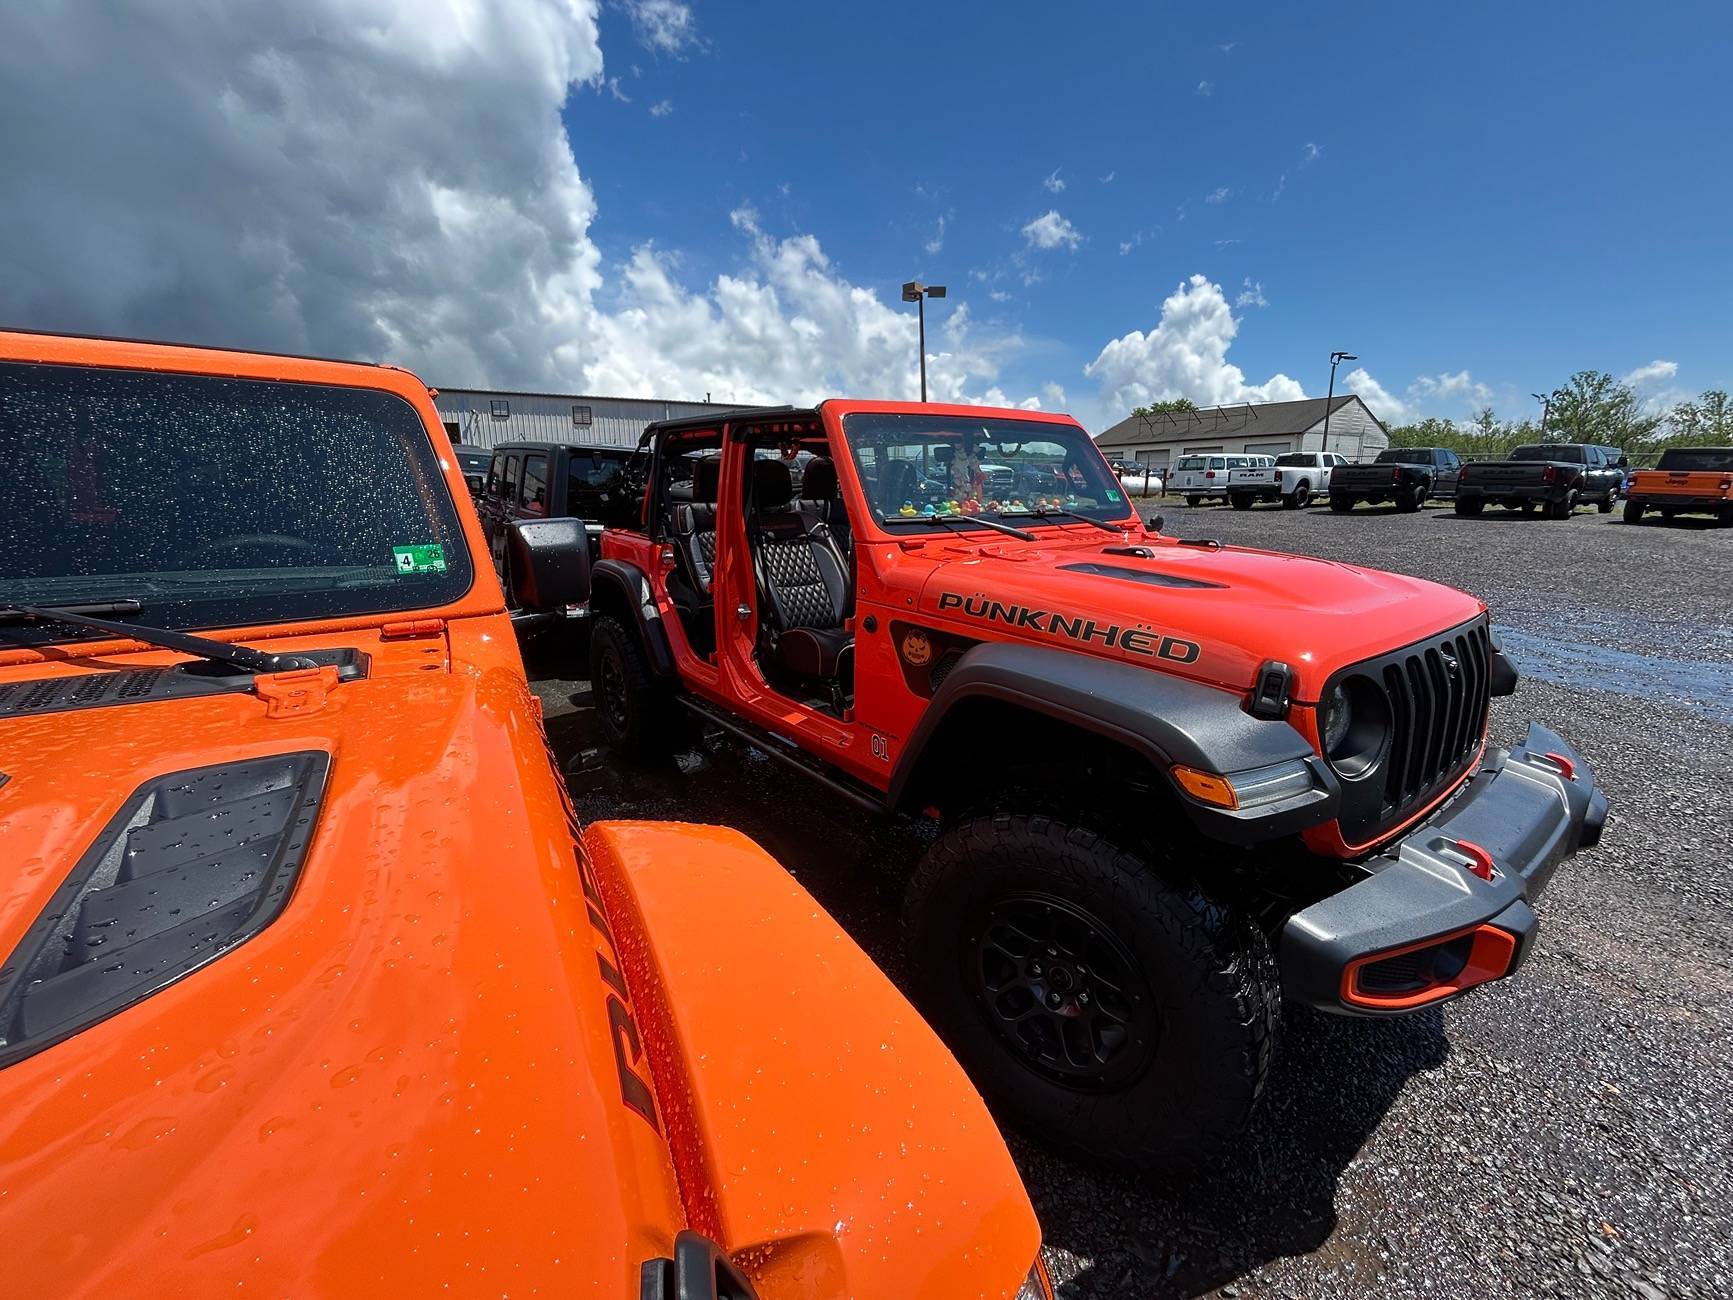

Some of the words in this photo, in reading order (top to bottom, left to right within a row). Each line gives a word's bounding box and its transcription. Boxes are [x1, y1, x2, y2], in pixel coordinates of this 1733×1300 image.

[401, 555, 411, 566] 4
[938, 591, 1202, 665] PÜNKNHËD
[871, 733, 889, 762] 01
